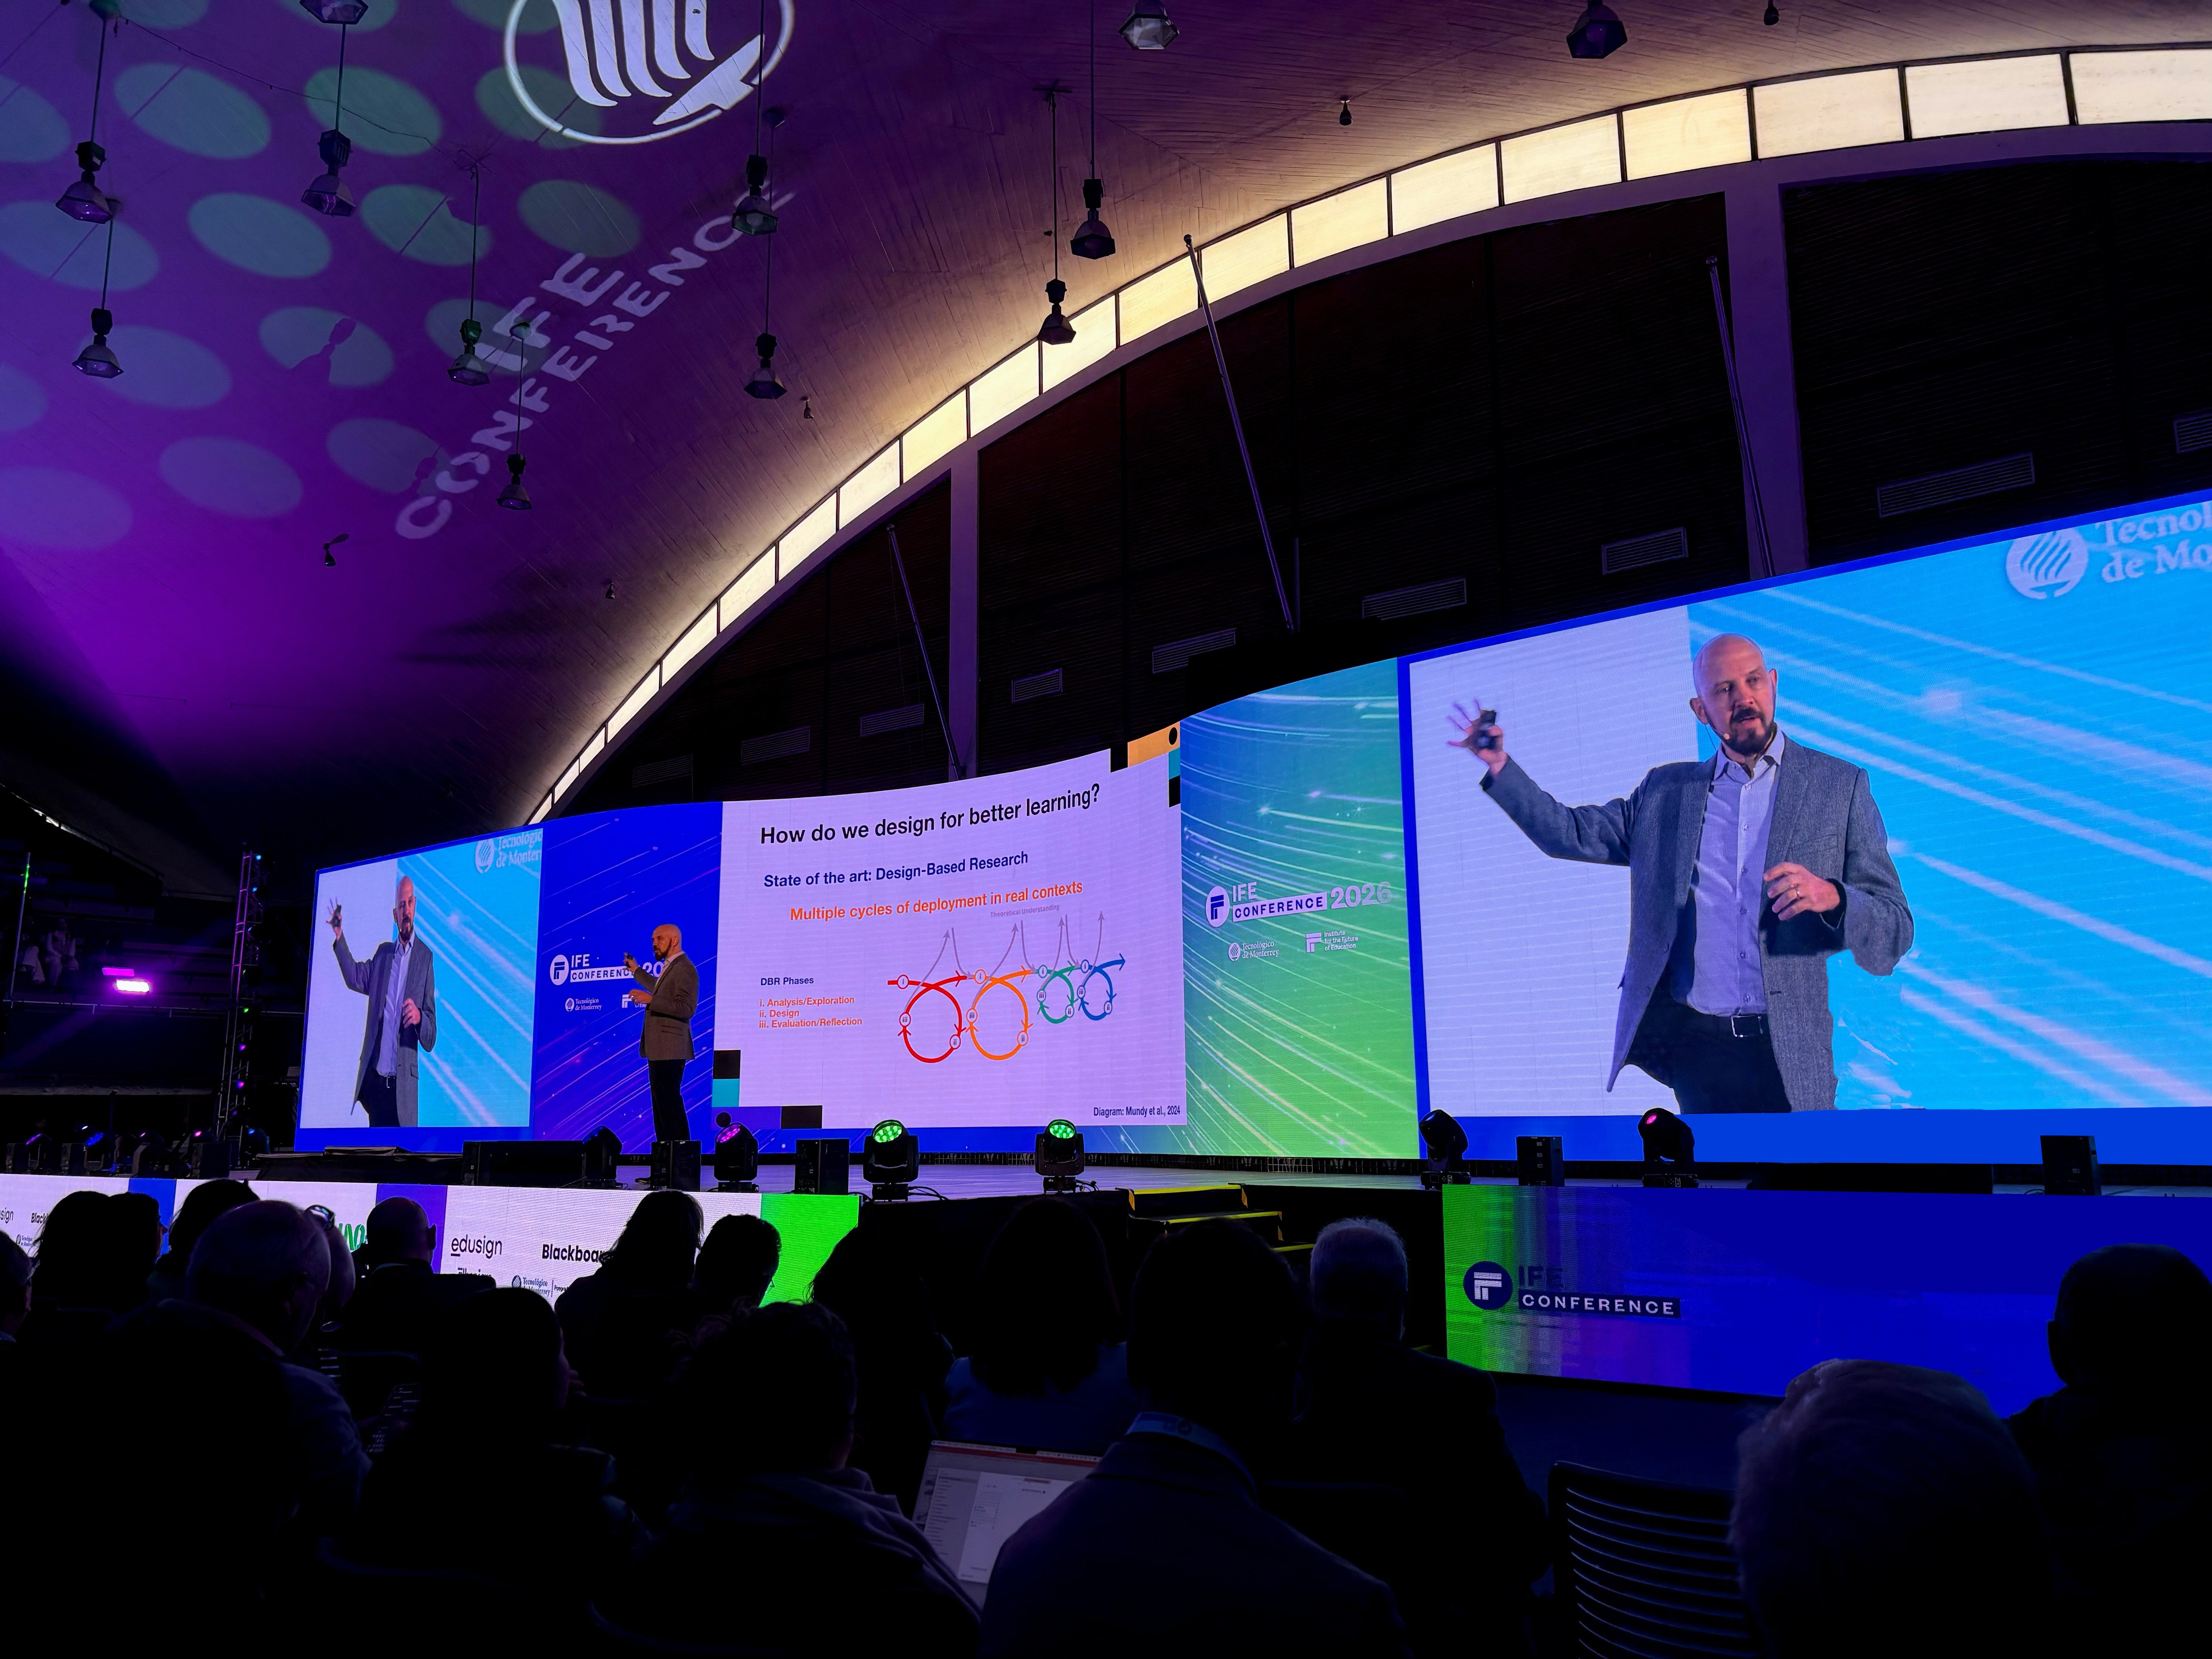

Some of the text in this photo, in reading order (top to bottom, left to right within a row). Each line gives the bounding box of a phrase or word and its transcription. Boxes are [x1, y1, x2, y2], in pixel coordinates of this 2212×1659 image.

[473, 252, 624, 372] IFE
[2102, 551, 2144, 583] de
[761, 783, 1100, 844] How do we design for better learning?
[764, 851, 1028, 887] State of the art: Design-Based Research
[1233, 881, 1257, 902] IFE
[1235, 881, 1392, 919] CONFERENCE 2026
[791, 881, 1082, 921] Multiple cycles of deployment in real contexts
[1022, 904, 1060, 914] Understanding
[1242, 941, 1274, 950] Tecnológico
[1250, 950, 1279, 958] Monterrey
[572, 954, 590, 968] IFE
[572, 961, 664, 980] CONFERENC 20
[767, 996, 854, 1007] Analysis/Exploration
[769, 1009, 799, 1018] Design
[772, 1018, 862, 1028] Evaluation/Reflection
[1094, 1105, 1180, 1118] Diagram: Mundy et al., 2024
[0, 1207, 14, 1224] sign
[31, 1212, 48, 1224] Black
[451, 1234, 502, 1259] edusign
[542, 1244, 601, 1262] Blackboa
[1518, 1266, 1563, 1288] IFE
[1522, 1294, 1674, 1315] CONFERENCE
